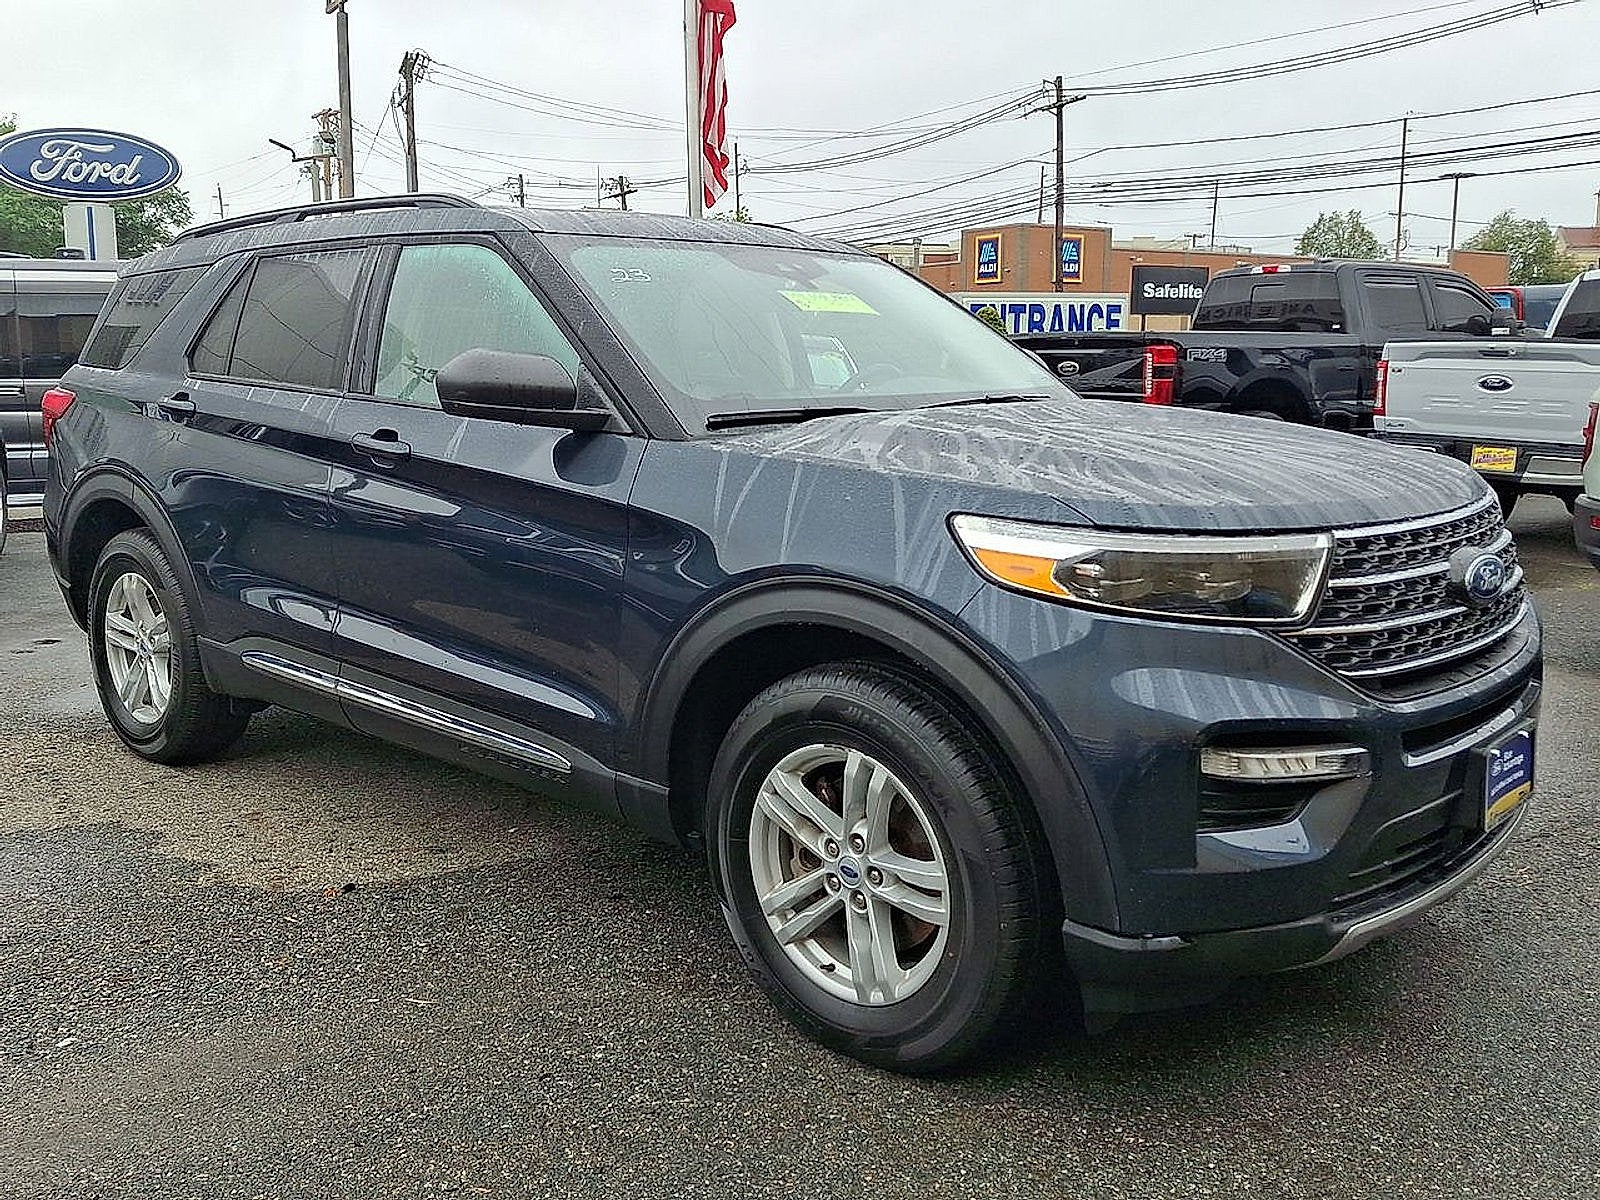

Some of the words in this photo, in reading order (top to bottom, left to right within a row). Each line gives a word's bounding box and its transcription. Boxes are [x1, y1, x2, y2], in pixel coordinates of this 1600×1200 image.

[29, 139, 143, 185] Ford
[979, 262, 997, 273] ALDI
[1062, 263, 1079, 273] LDI
[1142, 282, 1203, 299] Safelite
